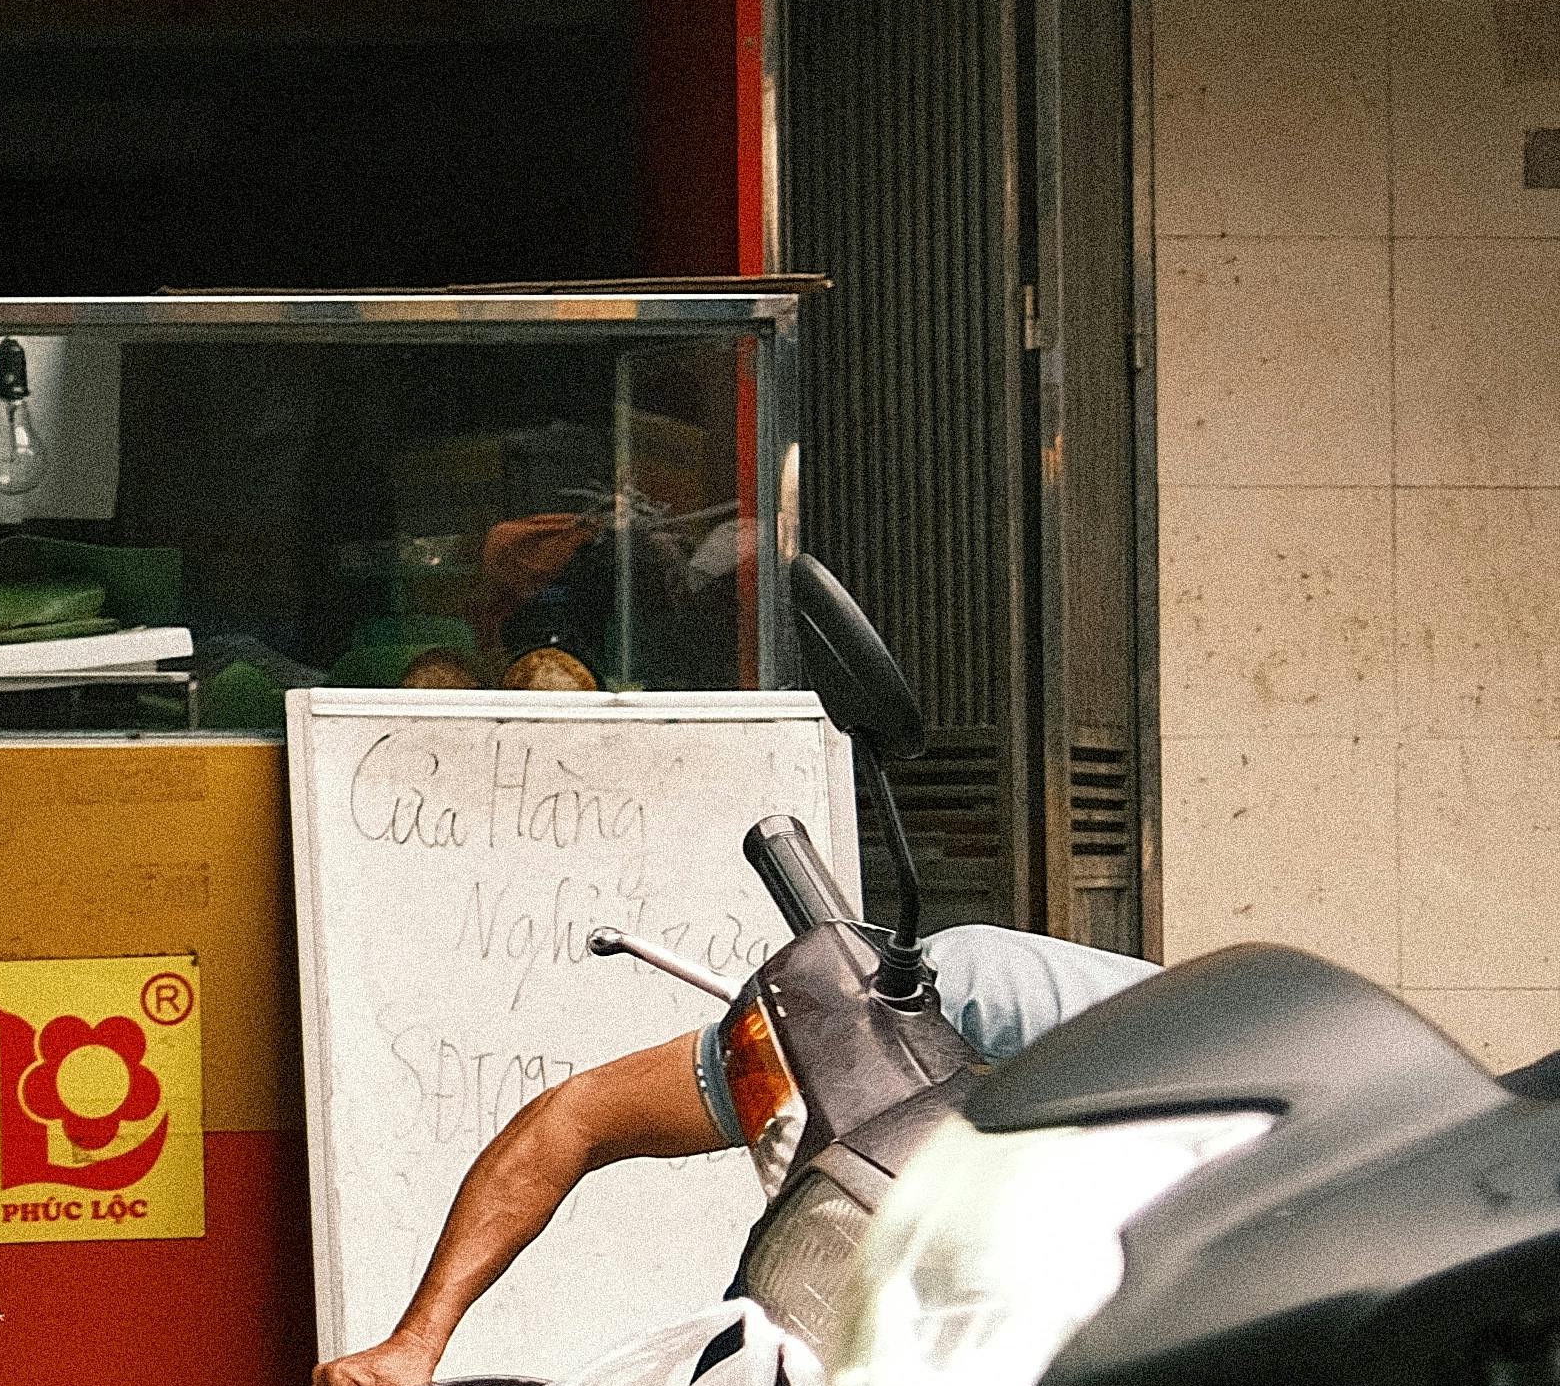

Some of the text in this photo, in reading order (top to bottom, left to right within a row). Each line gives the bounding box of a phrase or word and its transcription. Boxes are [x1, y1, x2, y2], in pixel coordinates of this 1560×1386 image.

[488, 737, 646, 875] Hàng
[2, 1194, 149, 1225] PHÚC LỘC
